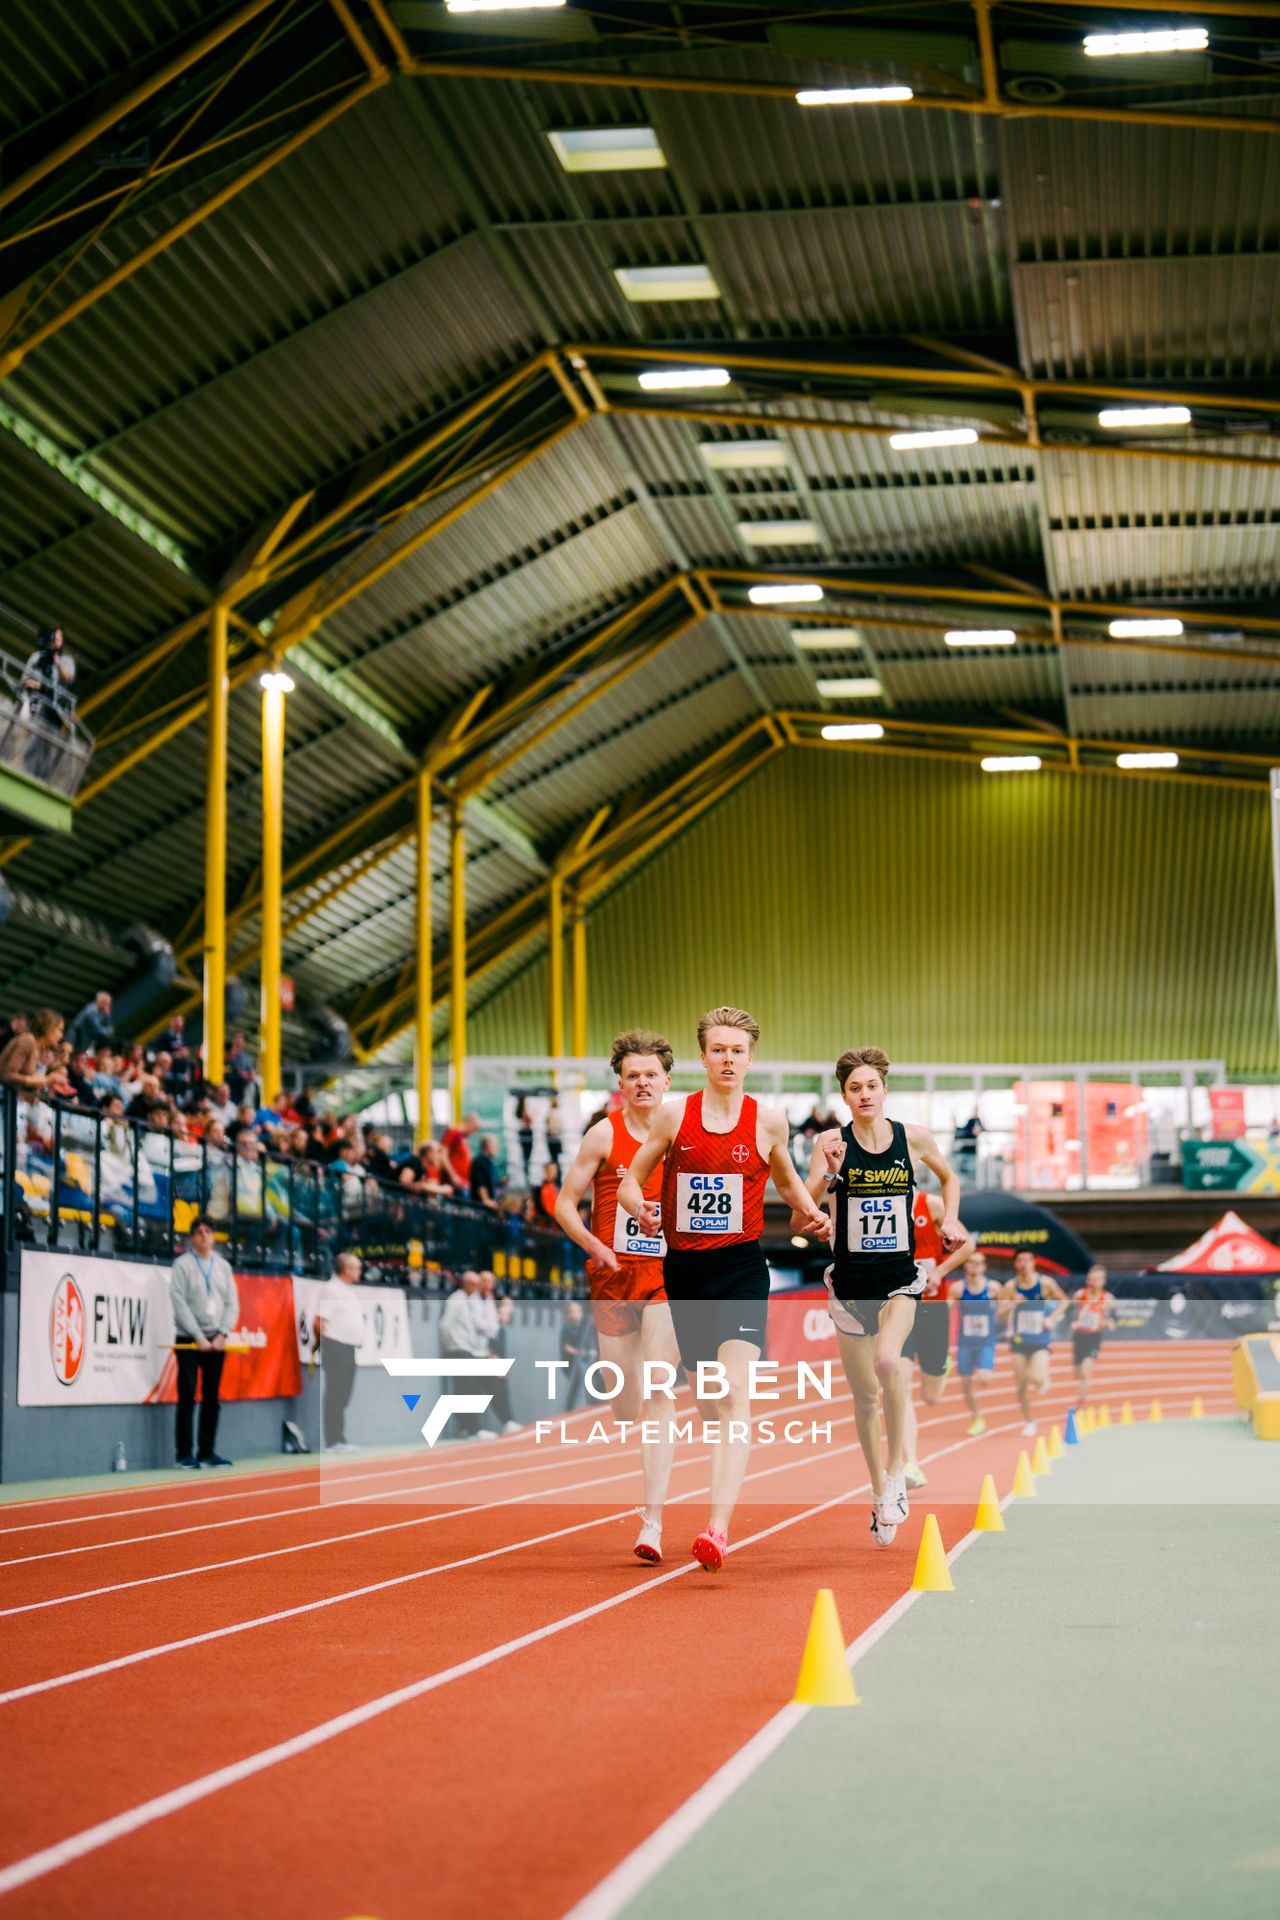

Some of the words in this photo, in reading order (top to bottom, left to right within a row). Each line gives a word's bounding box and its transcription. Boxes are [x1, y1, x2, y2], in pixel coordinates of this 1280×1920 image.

[687, 1193, 732, 1214] 428
[626, 1217, 663, 1239] 62
[705, 1218, 728, 1226] PLAN
[859, 1214, 897, 1235] 171
[641, 1241, 660, 1250] PLAN
[876, 1238, 896, 1246] PLAN
[94, 1295, 148, 1345] FLVW
